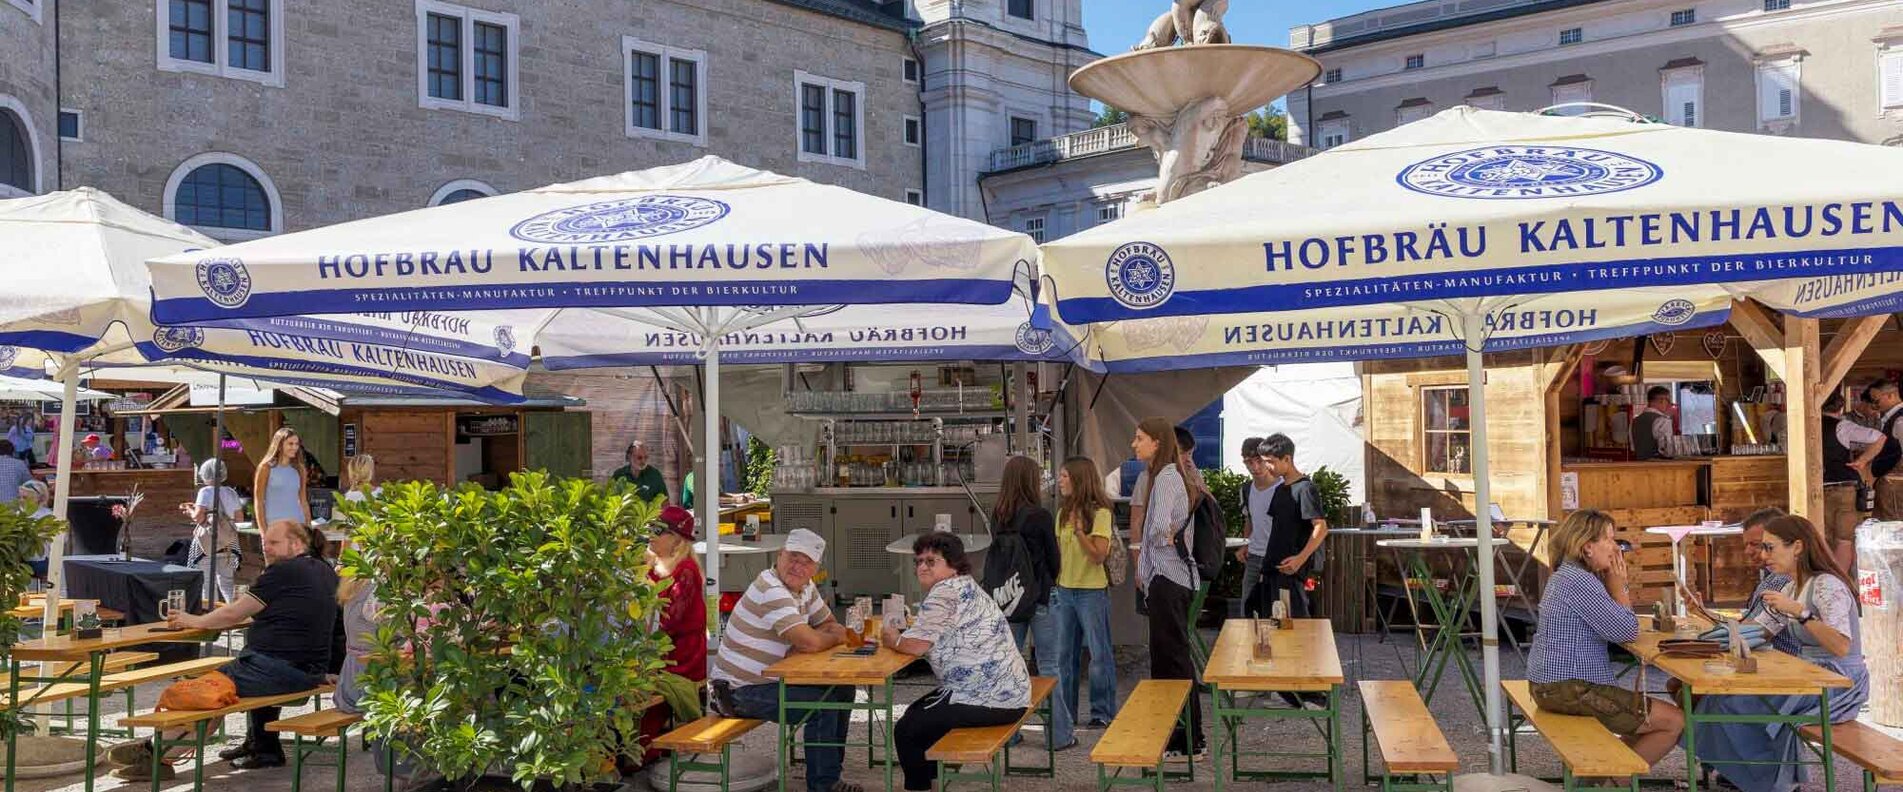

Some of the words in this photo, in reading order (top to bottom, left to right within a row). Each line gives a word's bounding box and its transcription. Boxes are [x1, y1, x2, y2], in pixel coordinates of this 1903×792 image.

[1263, 222, 1486, 272] HOFBRÄU
[1518, 201, 1903, 253] KALTENHAUSEN
[518, 242, 829, 272] KALTENHAUSEN
[574, 286, 664, 296] TREFFPUNKT
[672, 286, 699, 296] DER
[706, 284, 799, 296] BIERKULTUR
[1304, 271, 1562, 299] SPEZIALITÄTEN-MANUFAKTUR
[1588, 262, 1701, 280] TREFFPUNKT
[1711, 260, 1745, 273] DER
[1756, 254, 1873, 270] BIERKULTUR
[351, 343, 477, 379] KALTENHAUSEN
